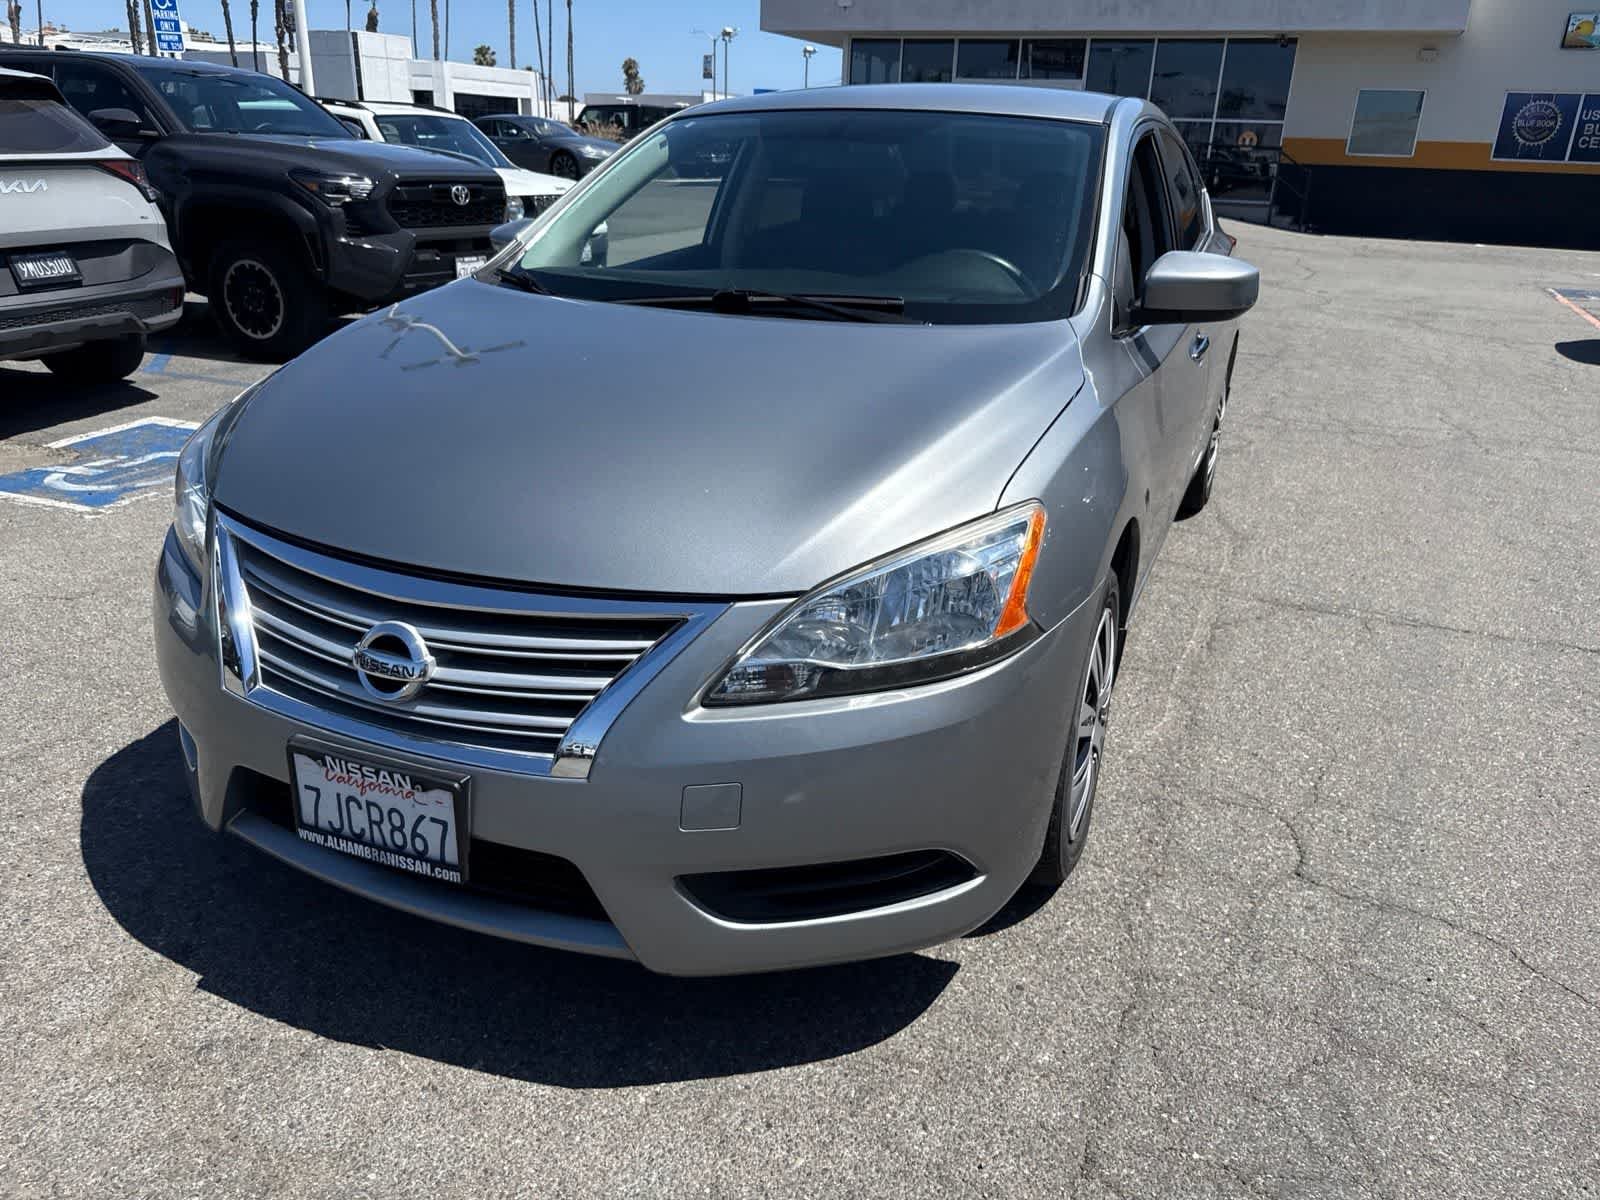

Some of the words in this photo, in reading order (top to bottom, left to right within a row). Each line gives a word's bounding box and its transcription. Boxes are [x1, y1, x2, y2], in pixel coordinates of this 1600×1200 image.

[153, 9, 179, 20] PARKING
[160, 20, 175, 31] ONLY
[1536, 119, 1556, 129] BOOK
[324, 755, 411, 790] NISSAN
[304, 785, 449, 864] 7JCR867
[298, 827, 462, 883] www.ALHAMBRANISSAN.com
